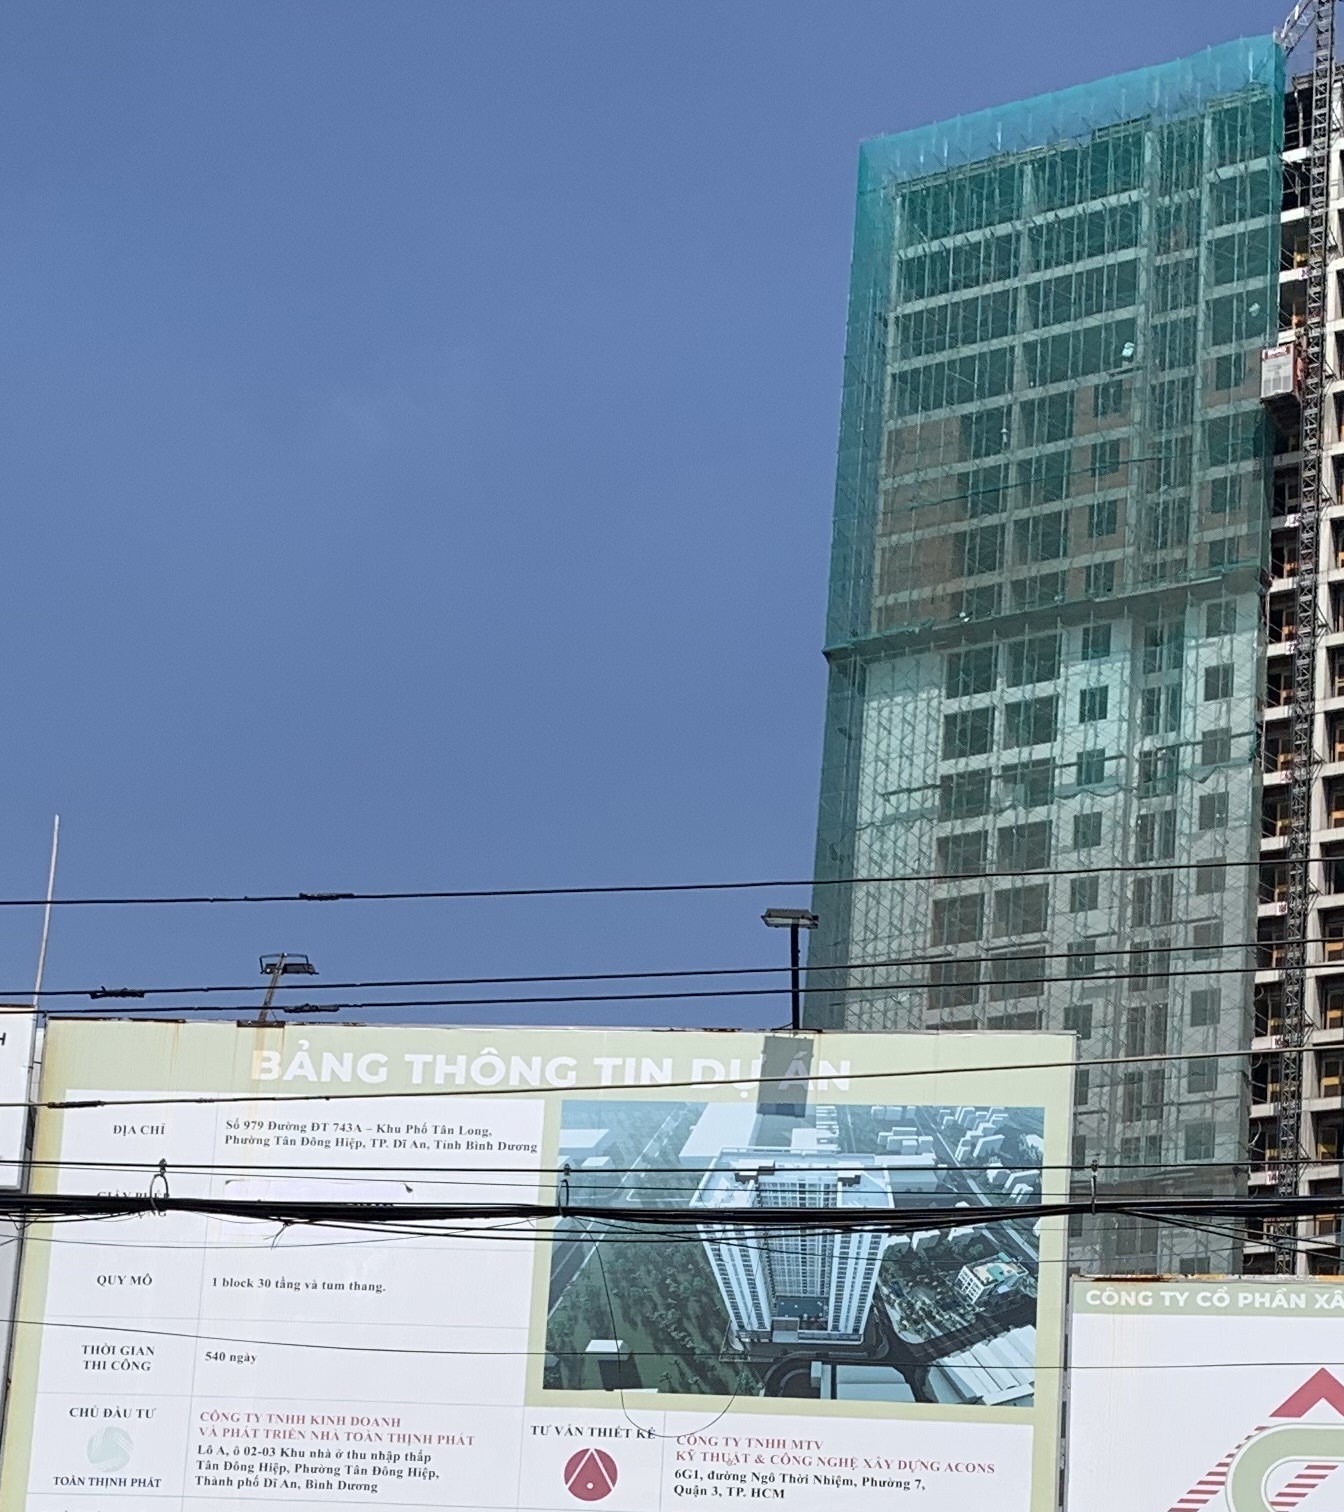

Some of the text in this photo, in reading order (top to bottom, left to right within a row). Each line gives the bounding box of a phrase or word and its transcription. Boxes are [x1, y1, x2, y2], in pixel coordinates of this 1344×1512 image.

[251, 1039, 852, 1099] BẢNG THÔNG TIN DỰ ÁN
[225, 1117, 240, 1130] Số
[242, 1119, 264, 1130] 979
[267, 1120, 307, 1134] Đường
[310, 1121, 330, 1132] ĐT
[332, 1122, 362, 1133] 743A
[376, 1123, 401, 1134] Khu
[405, 1121, 428, 1135] Phố
[431, 1124, 454, 1135] Tân
[96, 1272, 153, 1287] QUY MÔ
[211, 1275, 386, 1294] 1 block 30 tầng và tum thang.
[1085, 1286, 1154, 1308] CÔNG
[1160, 1288, 1188, 1308] TY
[1194, 1285, 1232, 1309] CỔ
[1237, 1285, 1308, 1310] PHẦN
[204, 1350, 259, 1366] 540 ngày
